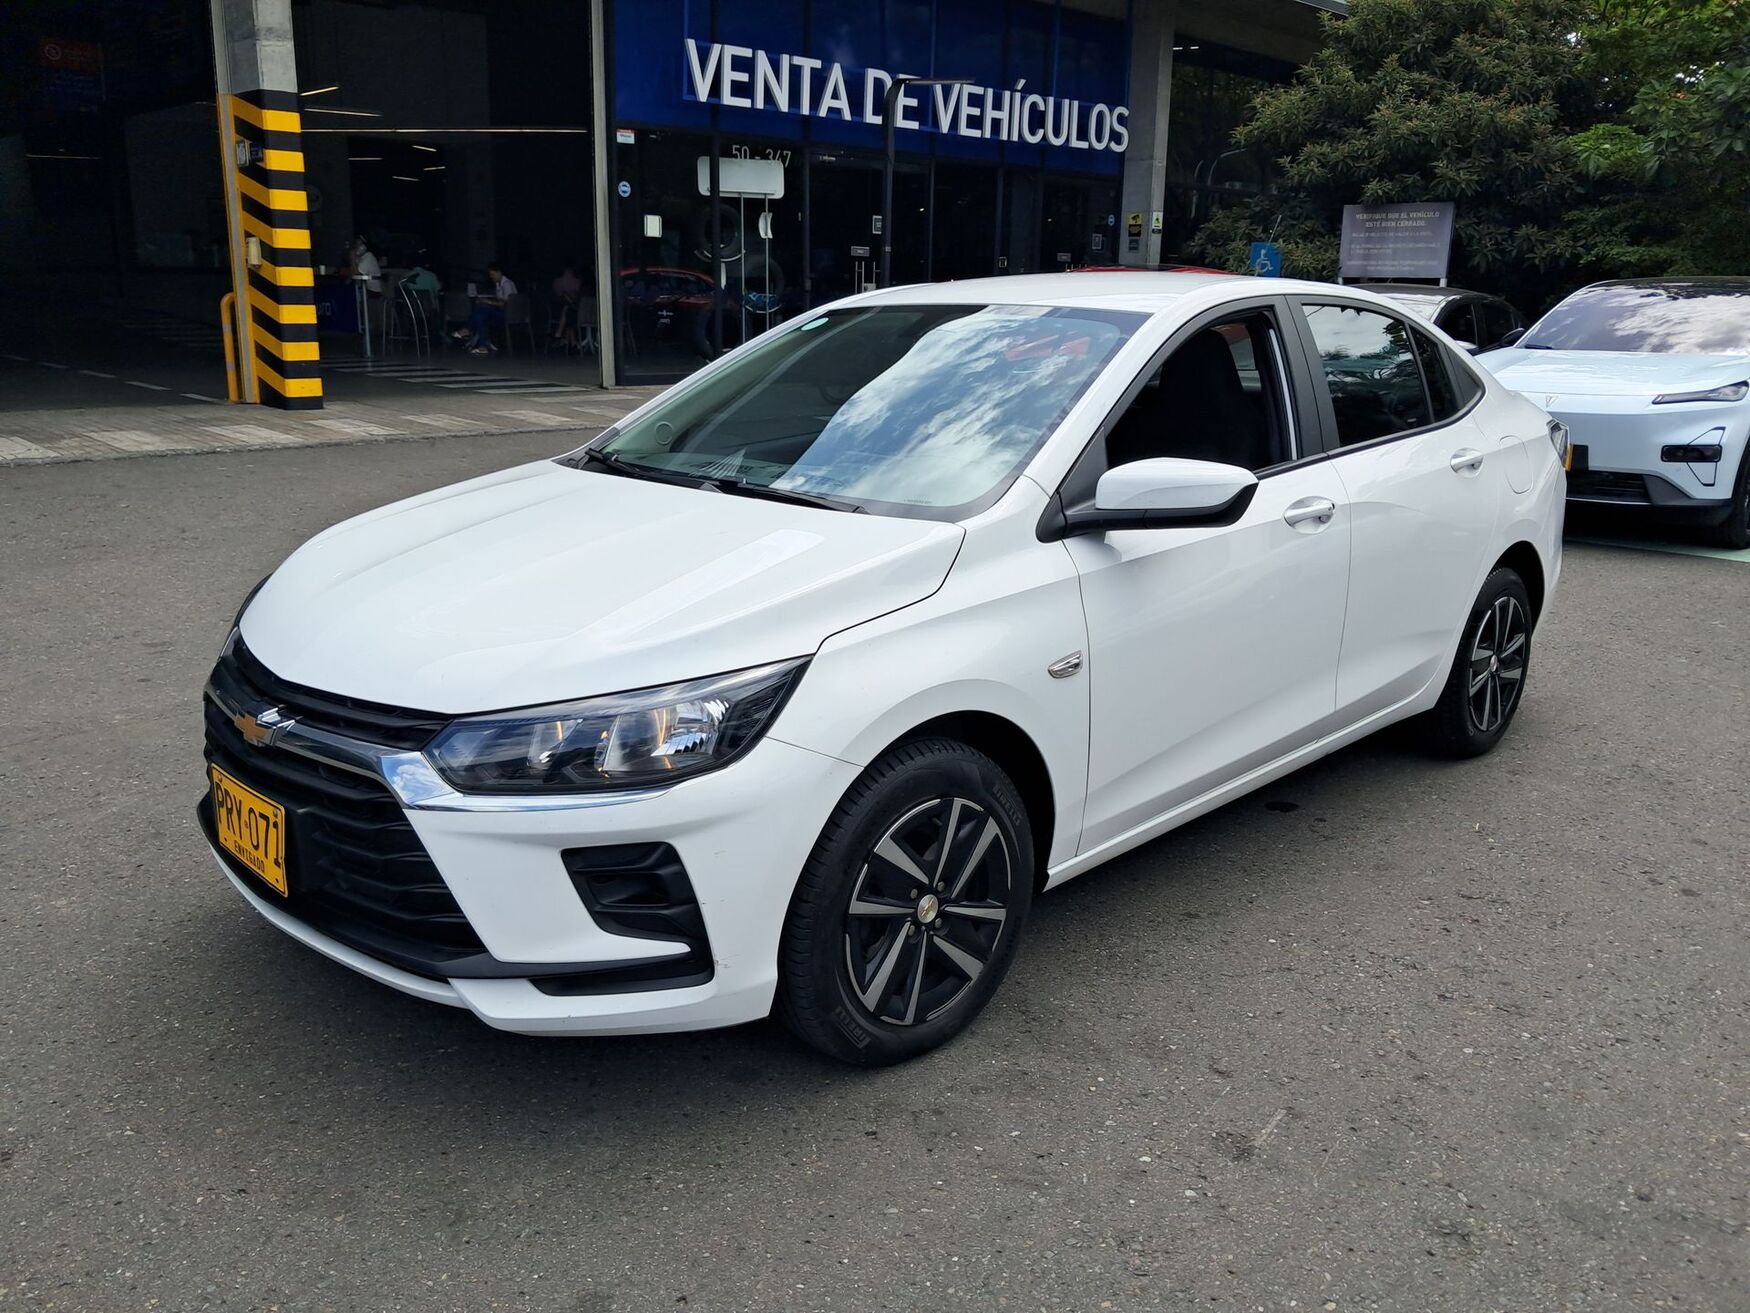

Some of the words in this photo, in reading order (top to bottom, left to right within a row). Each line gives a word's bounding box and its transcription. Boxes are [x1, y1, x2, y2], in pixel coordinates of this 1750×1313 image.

[685, 38, 852, 121] VENTA
[863, 68, 921, 130] DE
[935, 79, 1130, 153] VEHÍCULOS
[732, 145, 750, 160] 50
[234, 840, 266, 874] ENVIGADO
